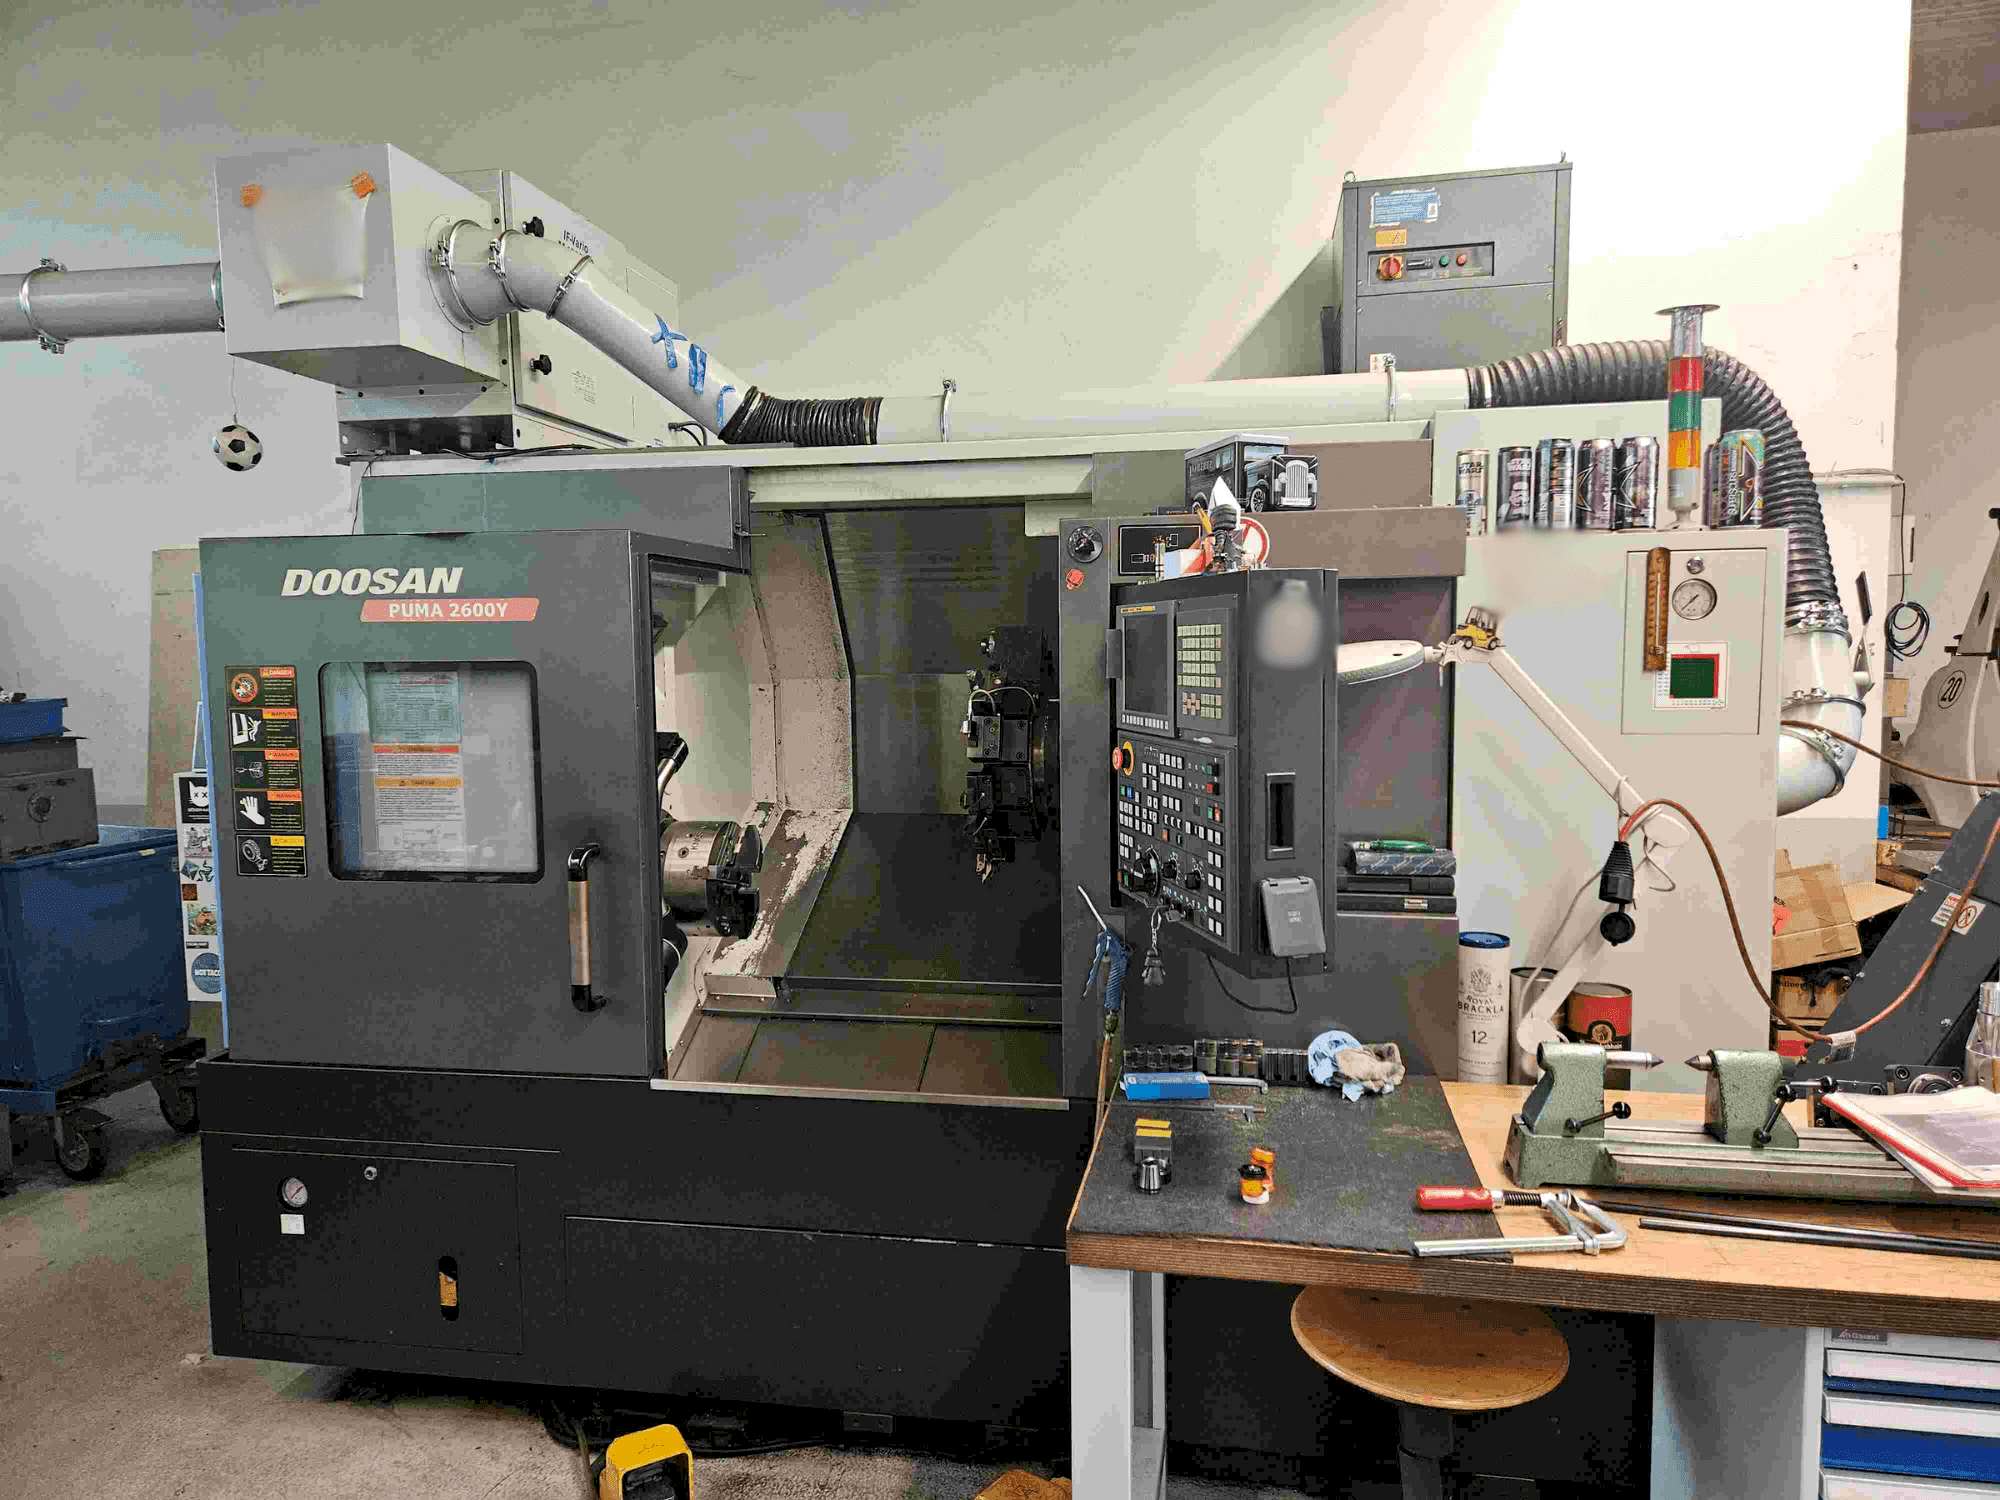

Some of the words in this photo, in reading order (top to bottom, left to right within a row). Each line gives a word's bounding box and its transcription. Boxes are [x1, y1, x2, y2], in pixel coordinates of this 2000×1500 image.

[563, 229, 589, 254] IF-Vario
[281, 567, 464, 597] DOOSAN
[388, 602, 444, 618] PUMA
[449, 602, 509, 618] 2600Y
[1940, 676, 1963, 702] 20
[1457, 1001, 1504, 1014] BRACKLA
[1472, 1029, 1488, 1045] 12
